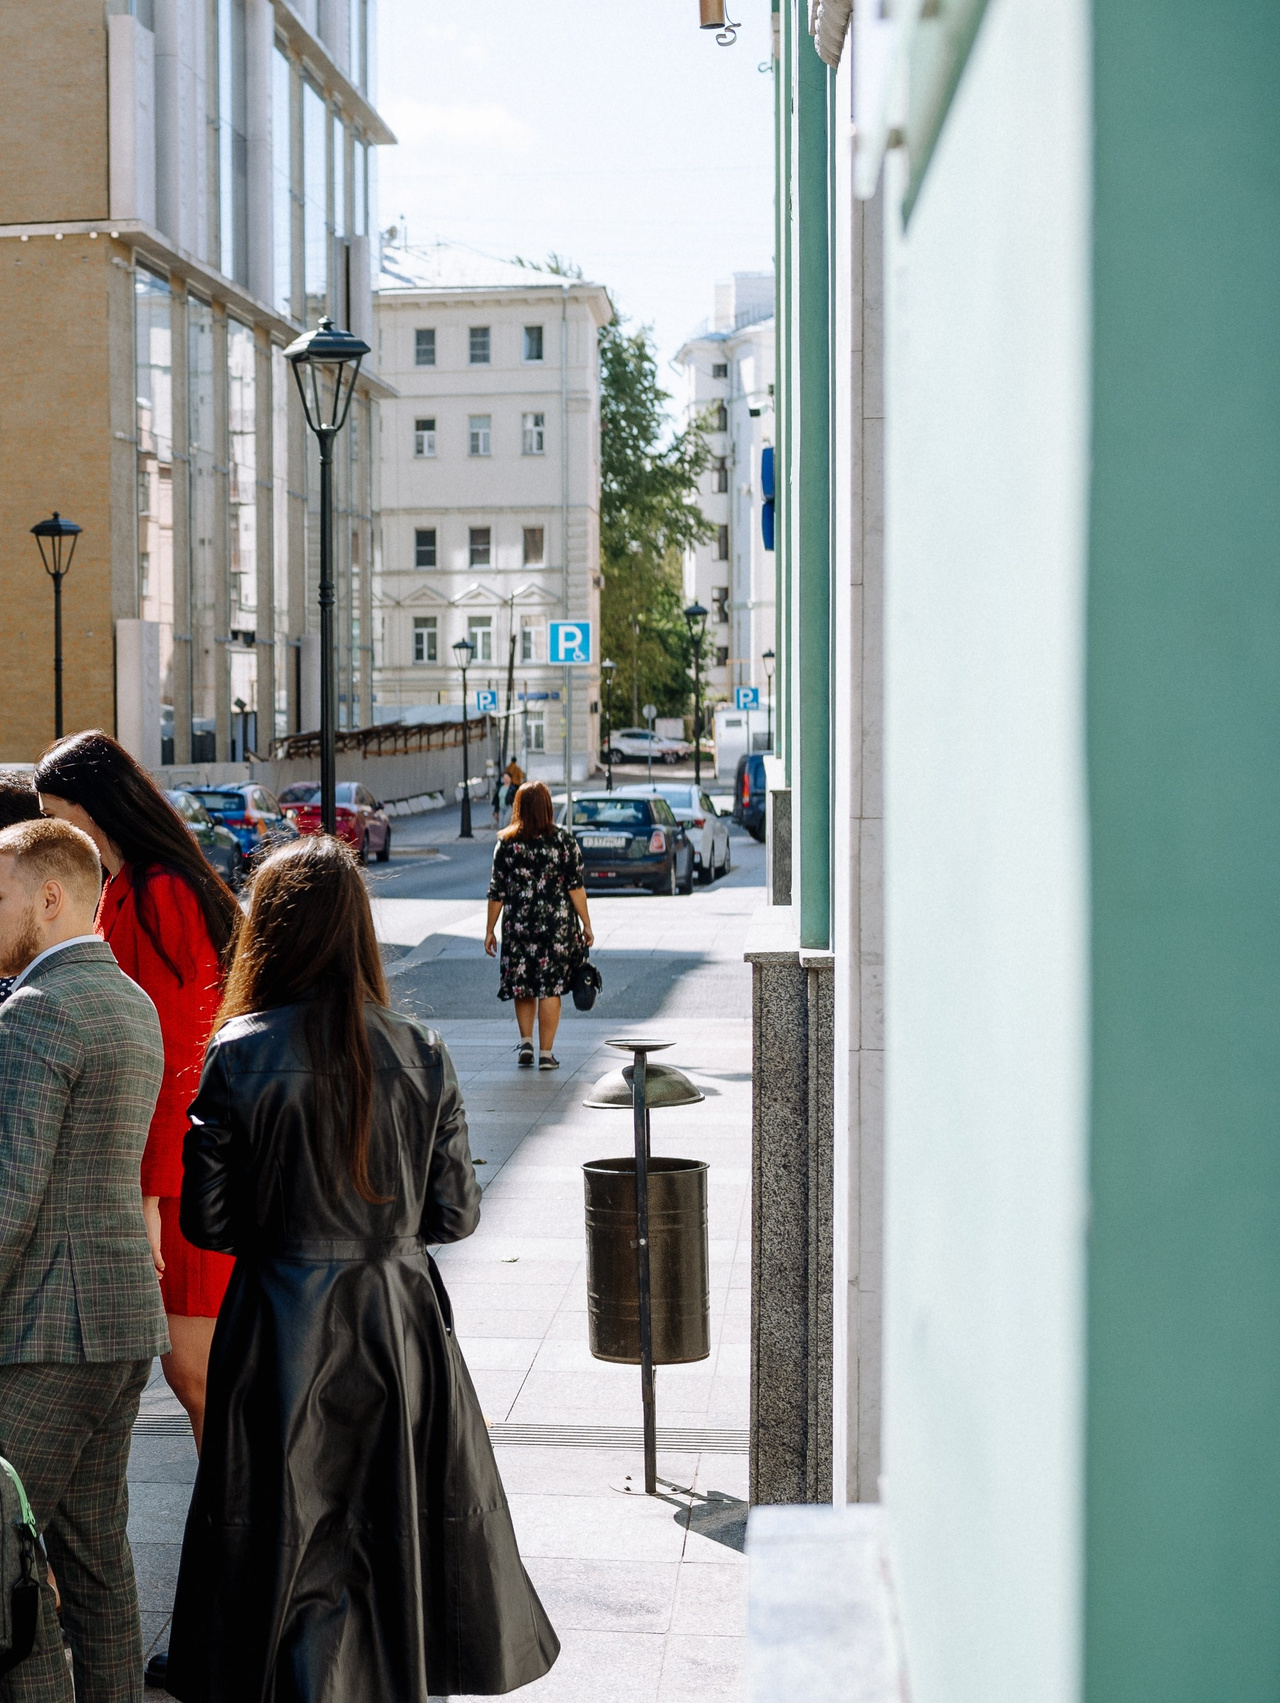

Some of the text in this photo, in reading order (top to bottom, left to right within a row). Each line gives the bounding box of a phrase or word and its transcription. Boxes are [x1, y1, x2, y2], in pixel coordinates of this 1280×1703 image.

[558, 625, 583, 660] P
[479, 692, 492, 710] P
[739, 689, 754, 709] P
